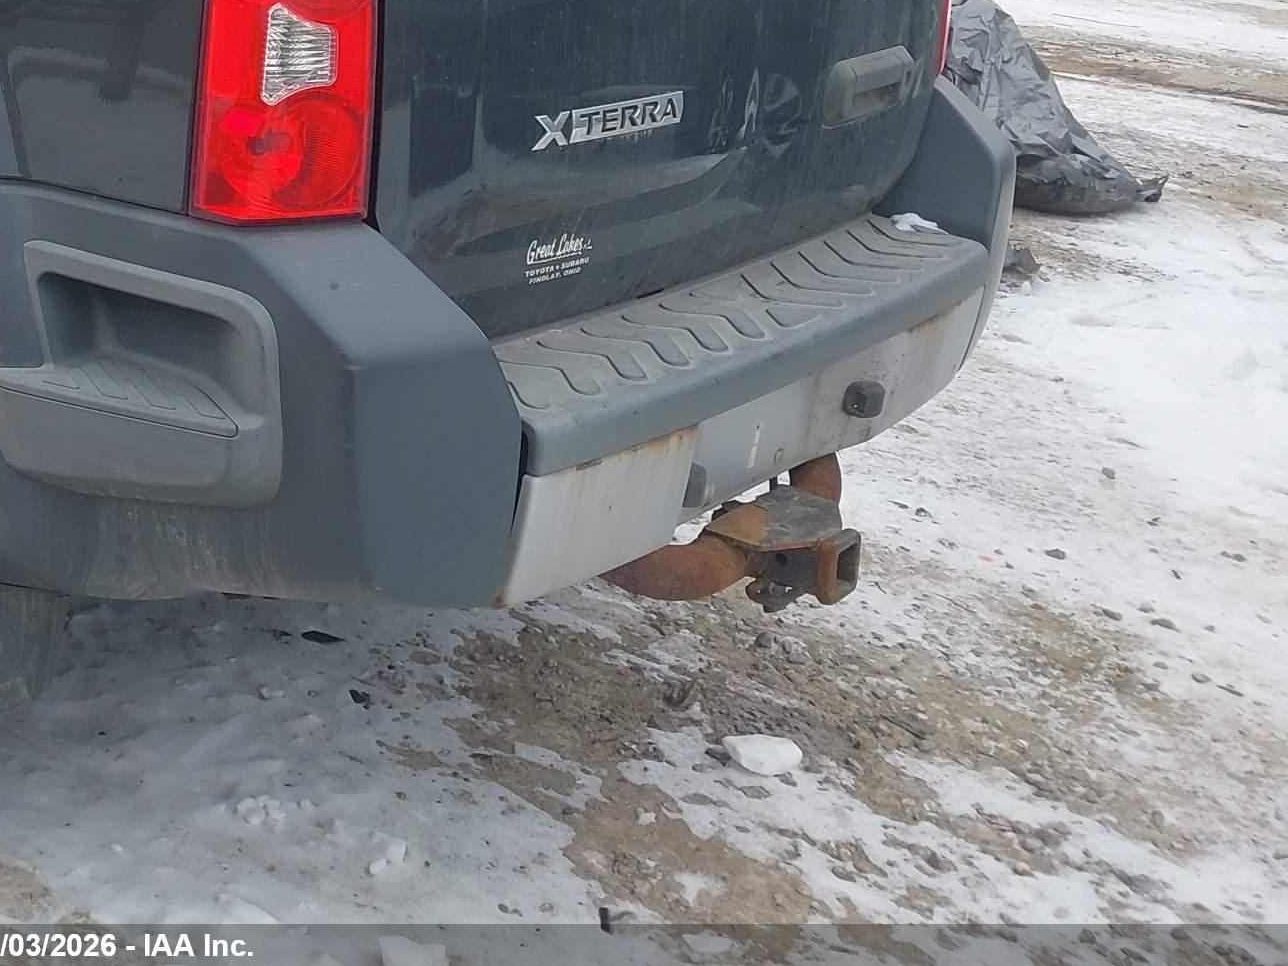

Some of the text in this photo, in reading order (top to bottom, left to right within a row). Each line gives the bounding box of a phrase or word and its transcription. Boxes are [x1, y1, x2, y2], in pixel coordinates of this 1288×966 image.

[531, 94, 680, 151] XTERRA
[526, 233, 584, 265] Great Lakes
[525, 257, 590, 278] TOYOTA SUBARU
[563, 267, 582, 277] OHIO
